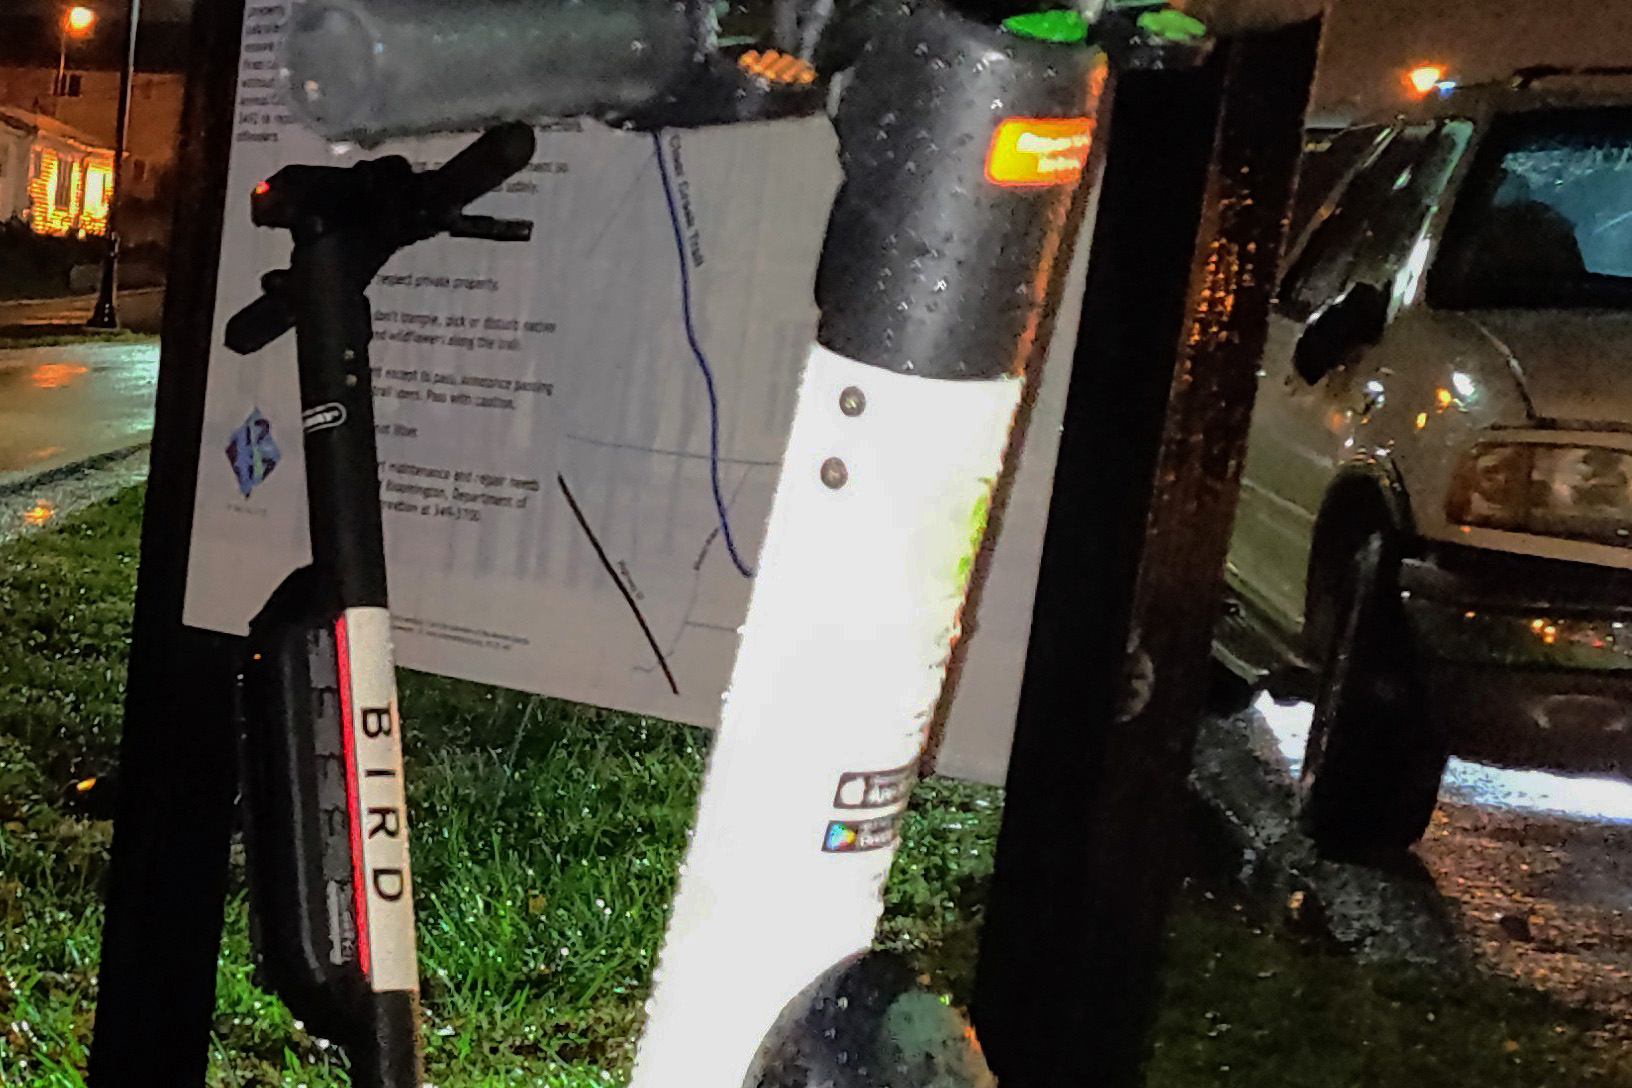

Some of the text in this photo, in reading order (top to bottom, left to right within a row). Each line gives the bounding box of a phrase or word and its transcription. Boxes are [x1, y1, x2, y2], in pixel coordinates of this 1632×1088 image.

[415, 276, 450, 289] private
[445, 315, 466, 328] pick
[448, 335, 475, 351] along
[477, 336, 495, 350] the
[450, 392, 472, 405] with
[388, 462, 451, 480] maintenance
[475, 474, 508, 488] repair
[452, 487, 513, 509] Department
[361, 707, 404, 901] BIRD
